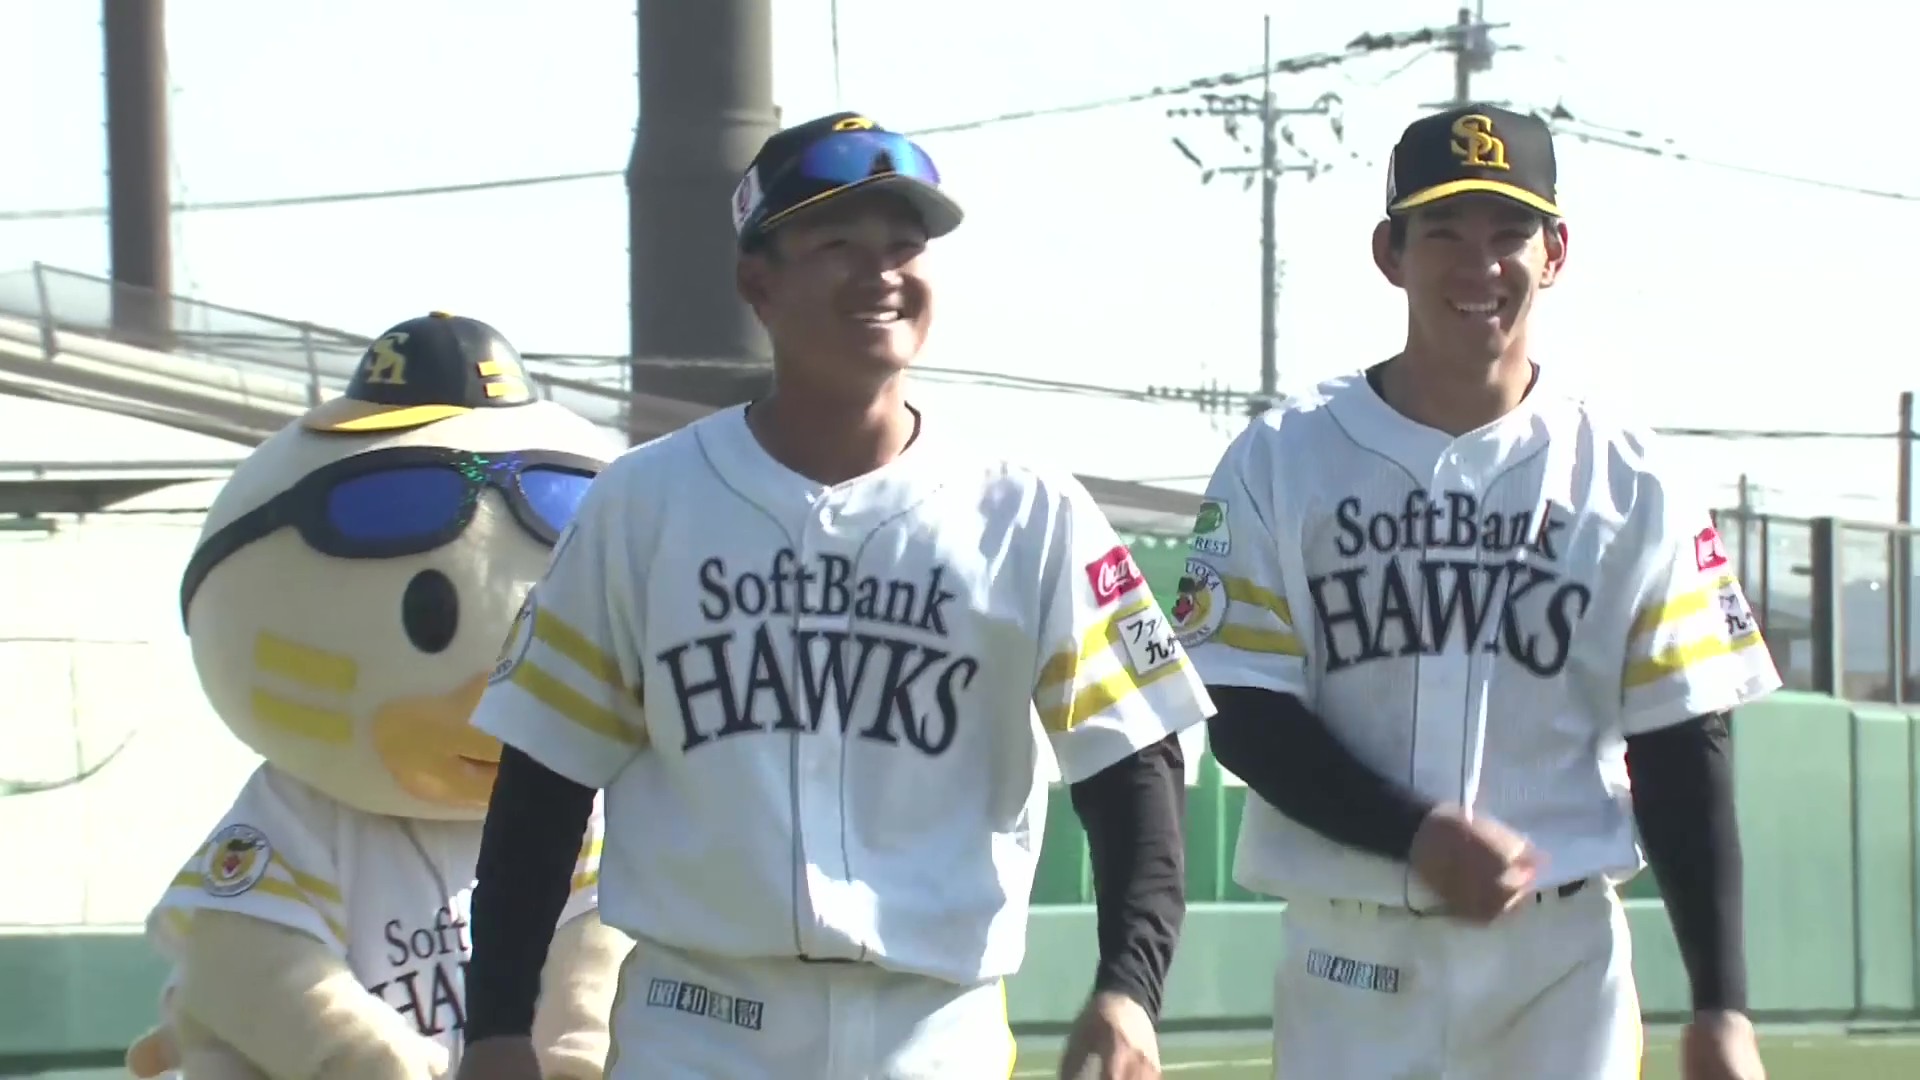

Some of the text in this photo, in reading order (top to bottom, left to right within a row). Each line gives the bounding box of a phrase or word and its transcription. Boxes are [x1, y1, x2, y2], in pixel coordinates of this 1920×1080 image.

[1334, 488, 1566, 562] SoftBank
[698, 548, 956, 638] SoftBank
[1126, 615, 1162, 645] ファ
[1306, 555, 1592, 679] HAWKS
[656, 620, 980, 757] HAWKS
[385, 906, 468, 967] Soft
